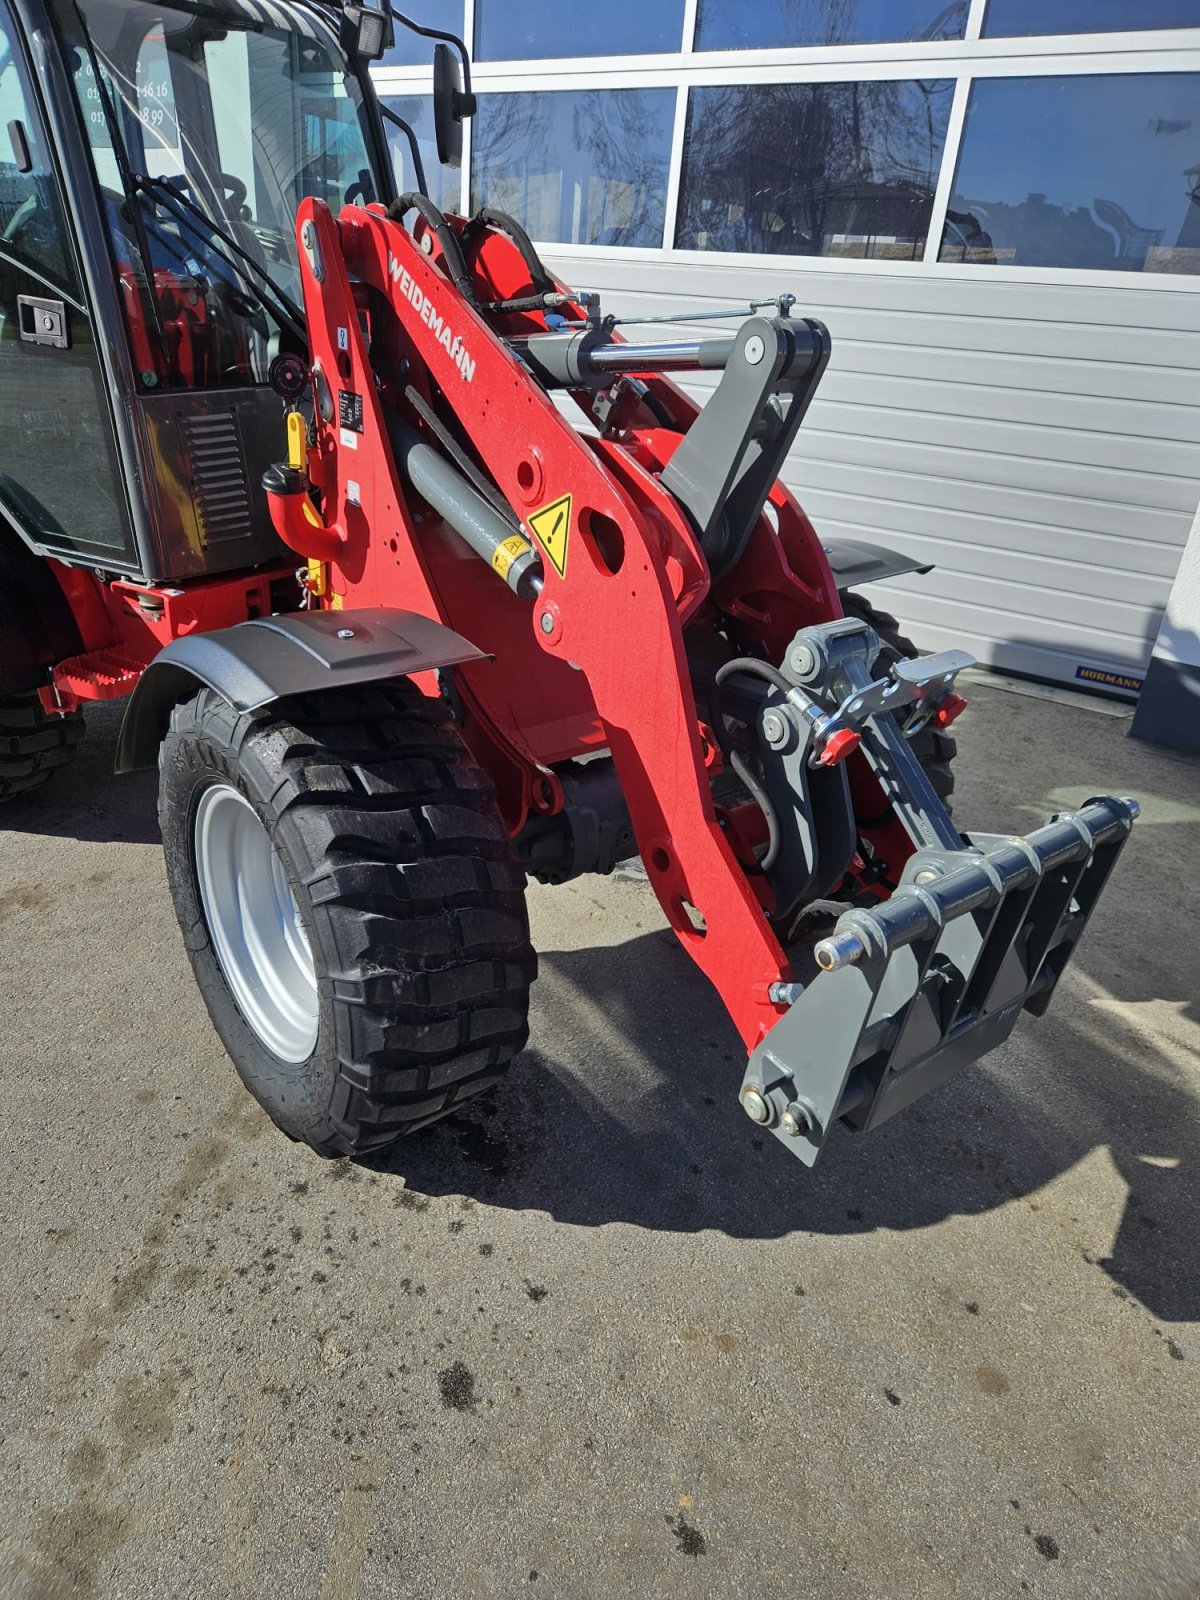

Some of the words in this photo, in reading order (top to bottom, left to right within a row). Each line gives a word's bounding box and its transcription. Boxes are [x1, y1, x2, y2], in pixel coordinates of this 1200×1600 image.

[156, 81, 168, 97] 16
[151, 109, 164, 126] 99
[388, 250, 477, 382] WEIDEMANN
